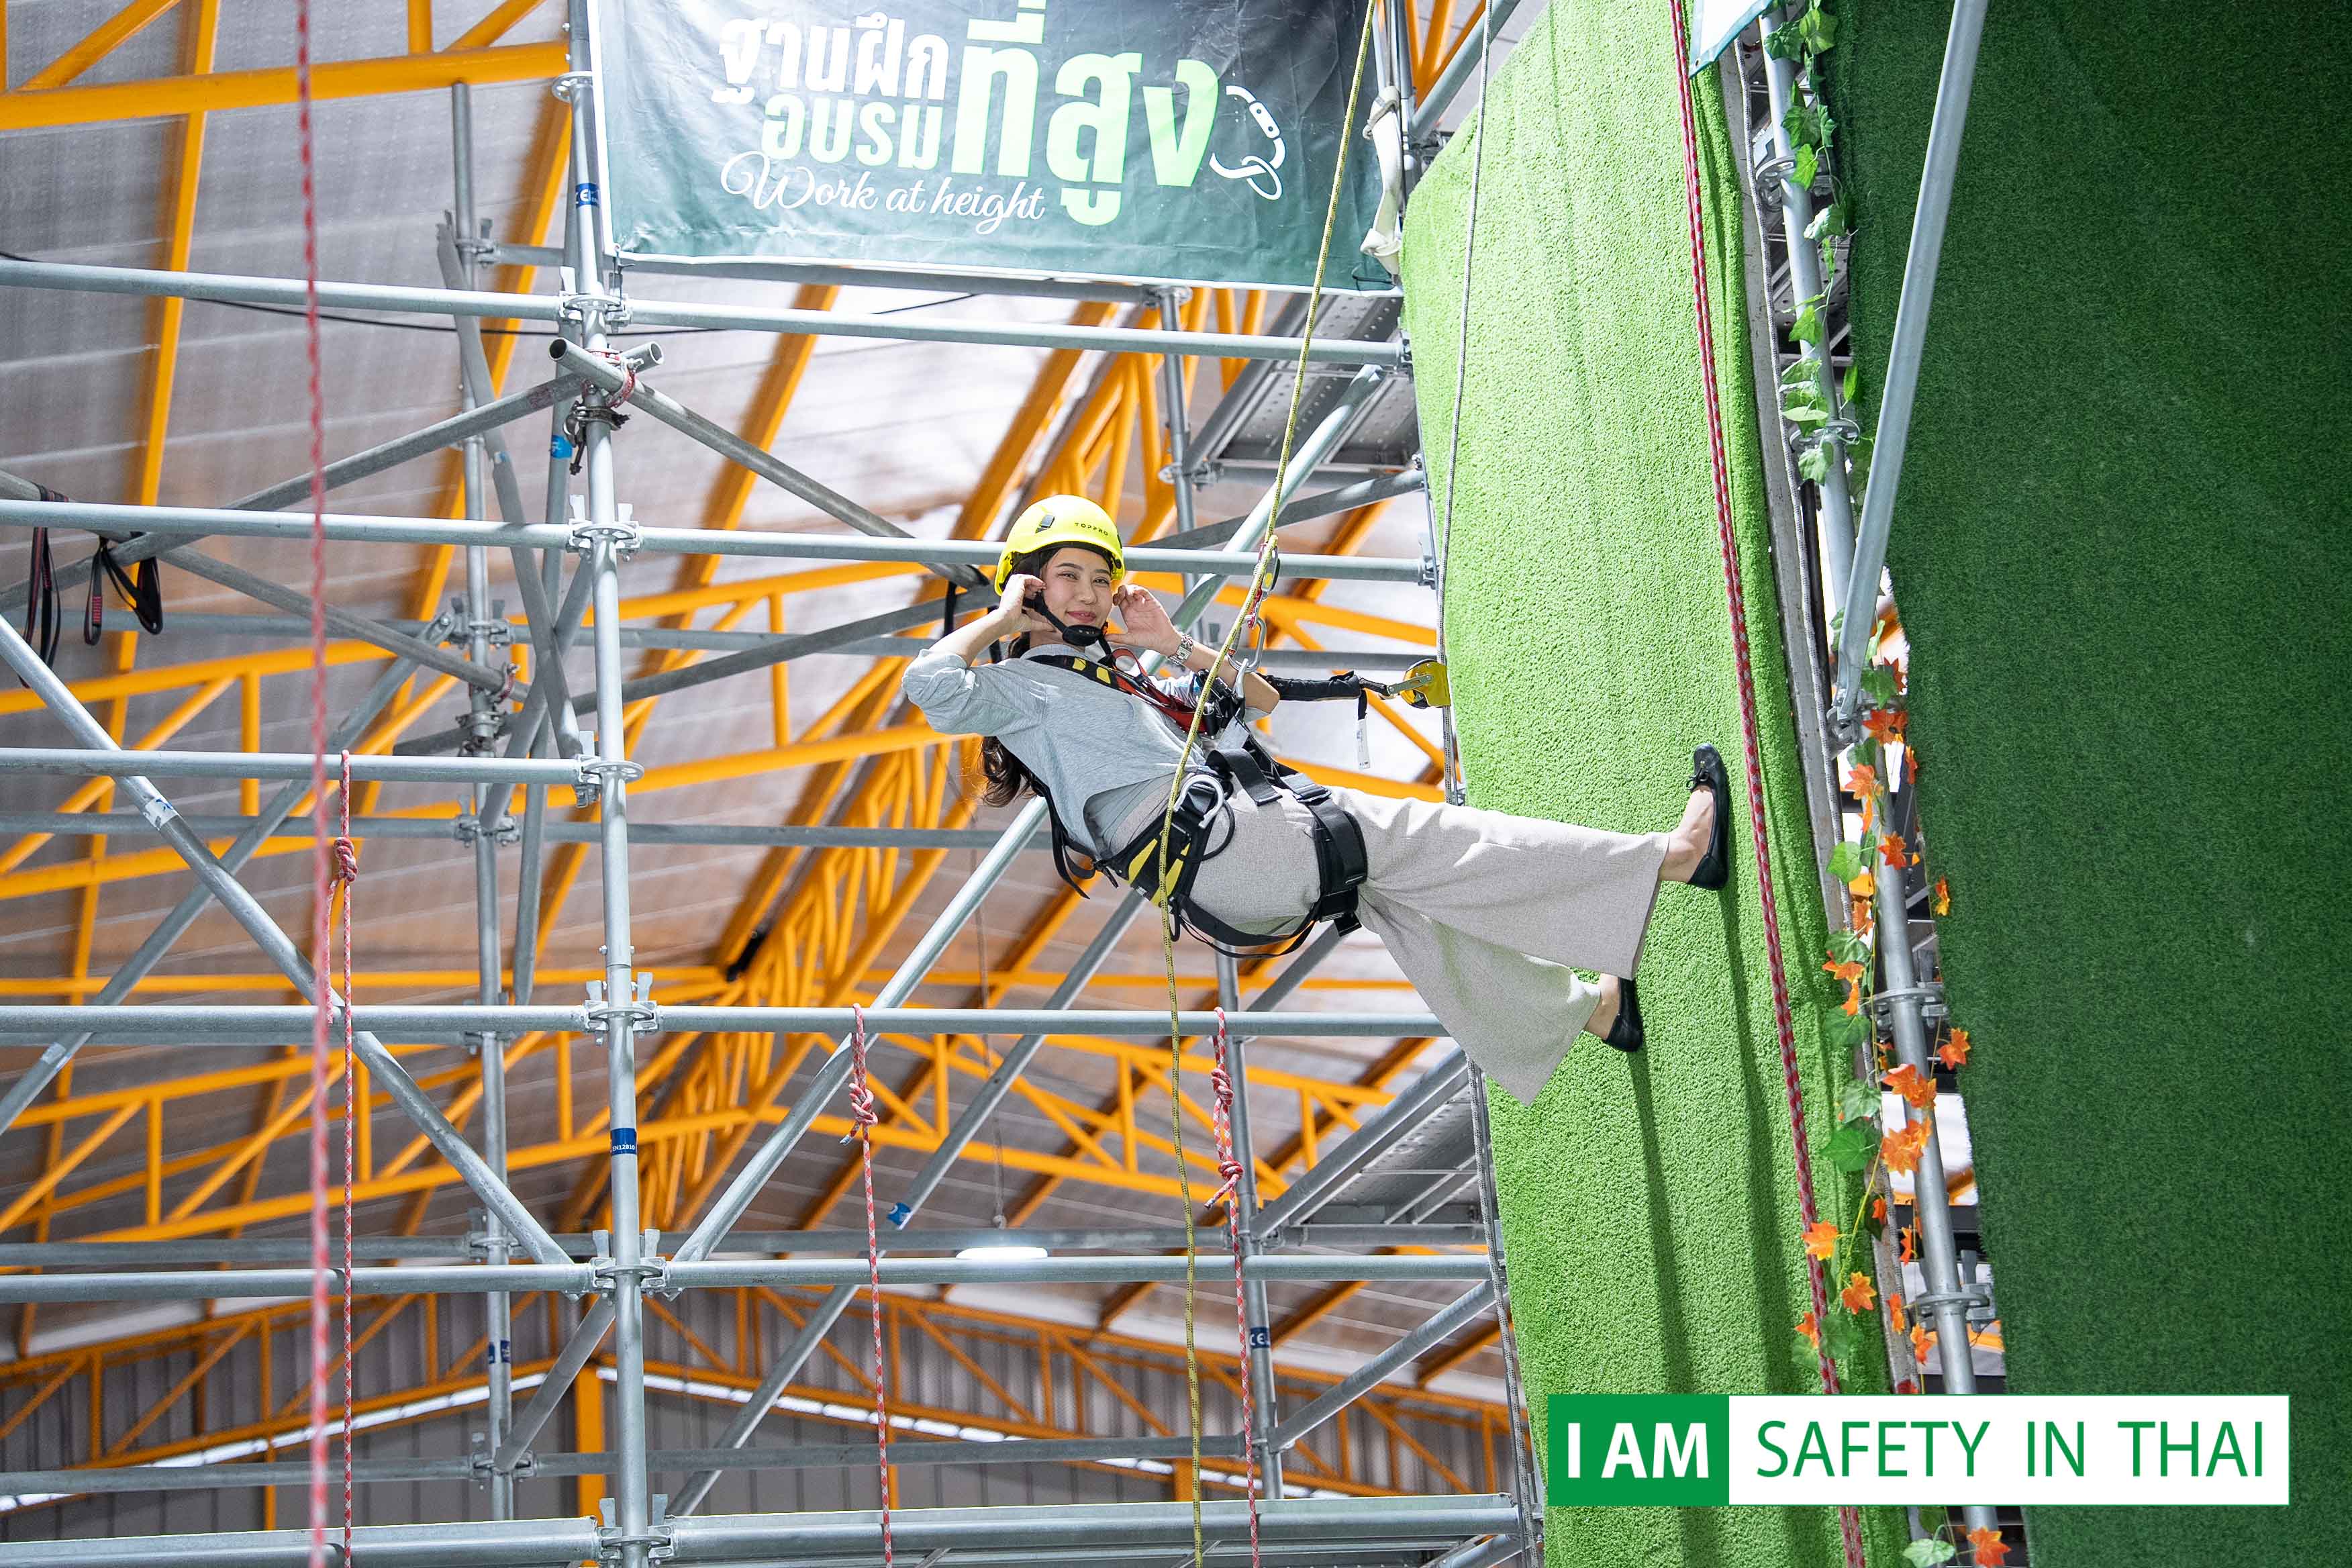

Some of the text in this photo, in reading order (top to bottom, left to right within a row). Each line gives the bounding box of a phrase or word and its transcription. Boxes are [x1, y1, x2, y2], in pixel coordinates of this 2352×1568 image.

[710, 11, 950, 105] ฐานฝึก
[761, 93, 944, 170] อบรม
[720, 150, 1046, 235] Work at height
